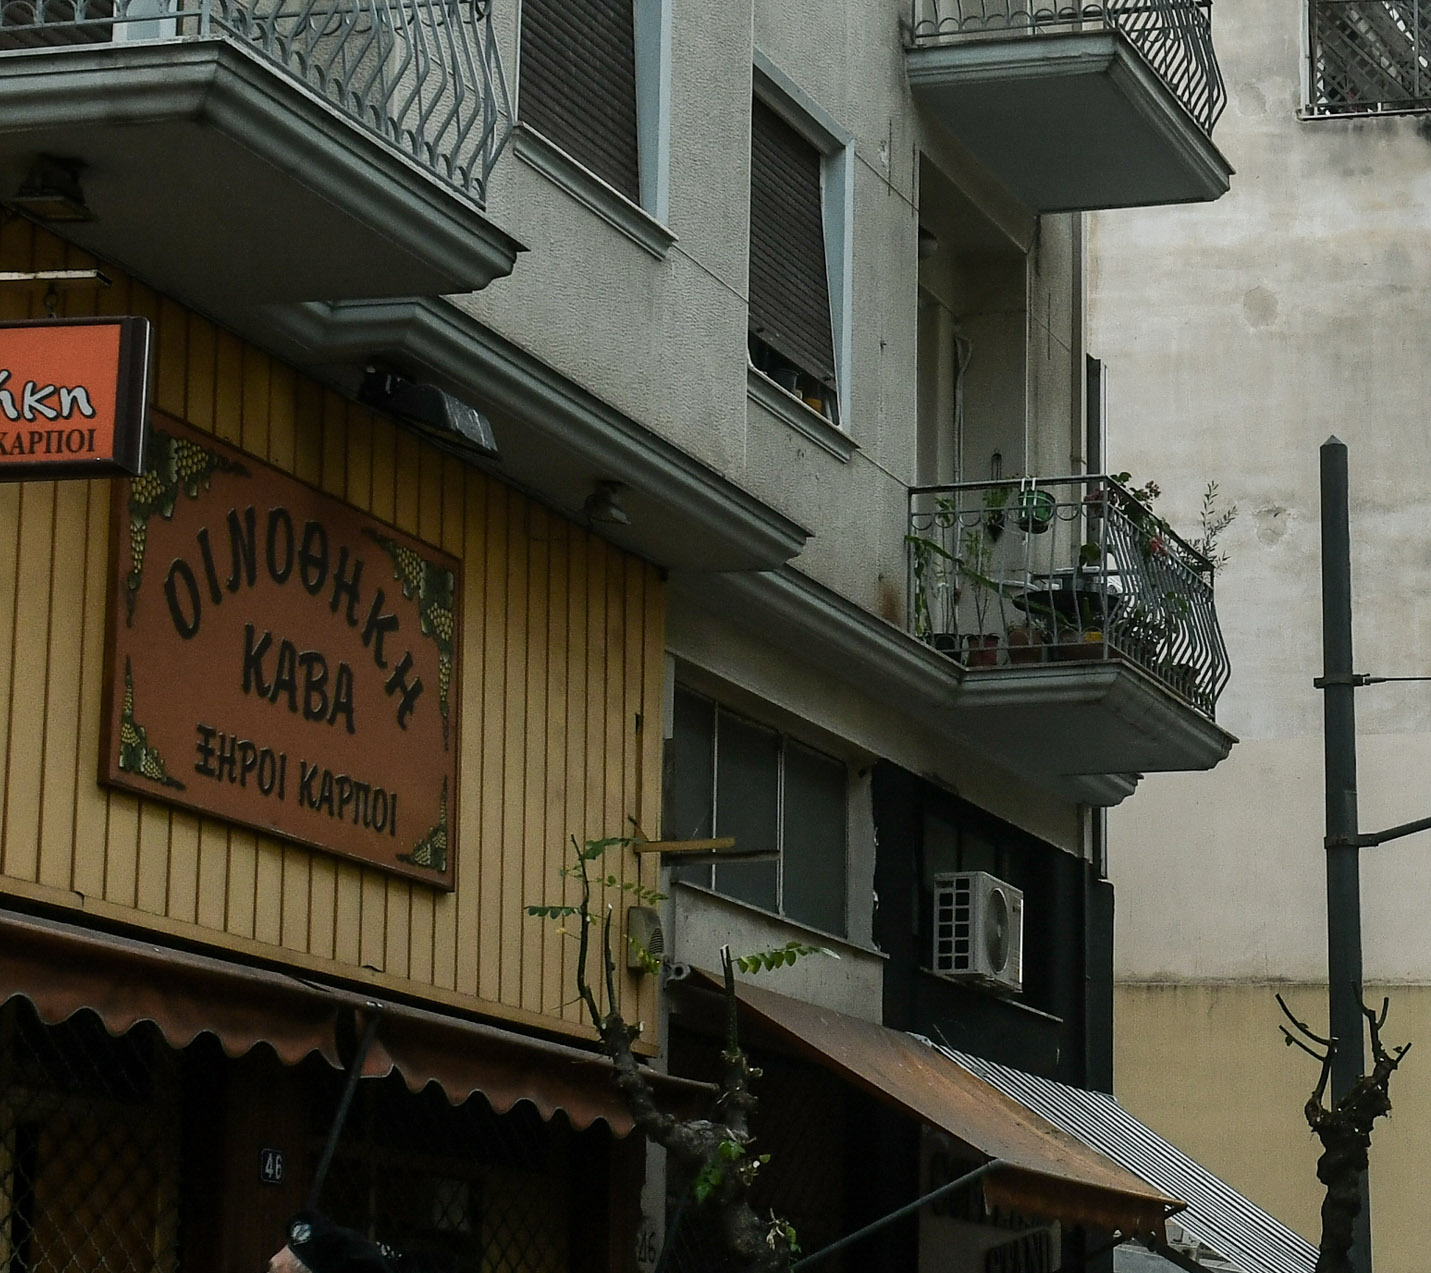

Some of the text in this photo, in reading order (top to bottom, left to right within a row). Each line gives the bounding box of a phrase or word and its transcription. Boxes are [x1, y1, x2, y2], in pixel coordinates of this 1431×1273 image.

[163, 507, 424, 730] ΟΙΝΟΘΗΚΗ
[242, 622, 356, 734] ΚΑΒΑ
[195, 725, 397, 836] ΞΗΡΟΙ ΚΑΡΠΟΙ
